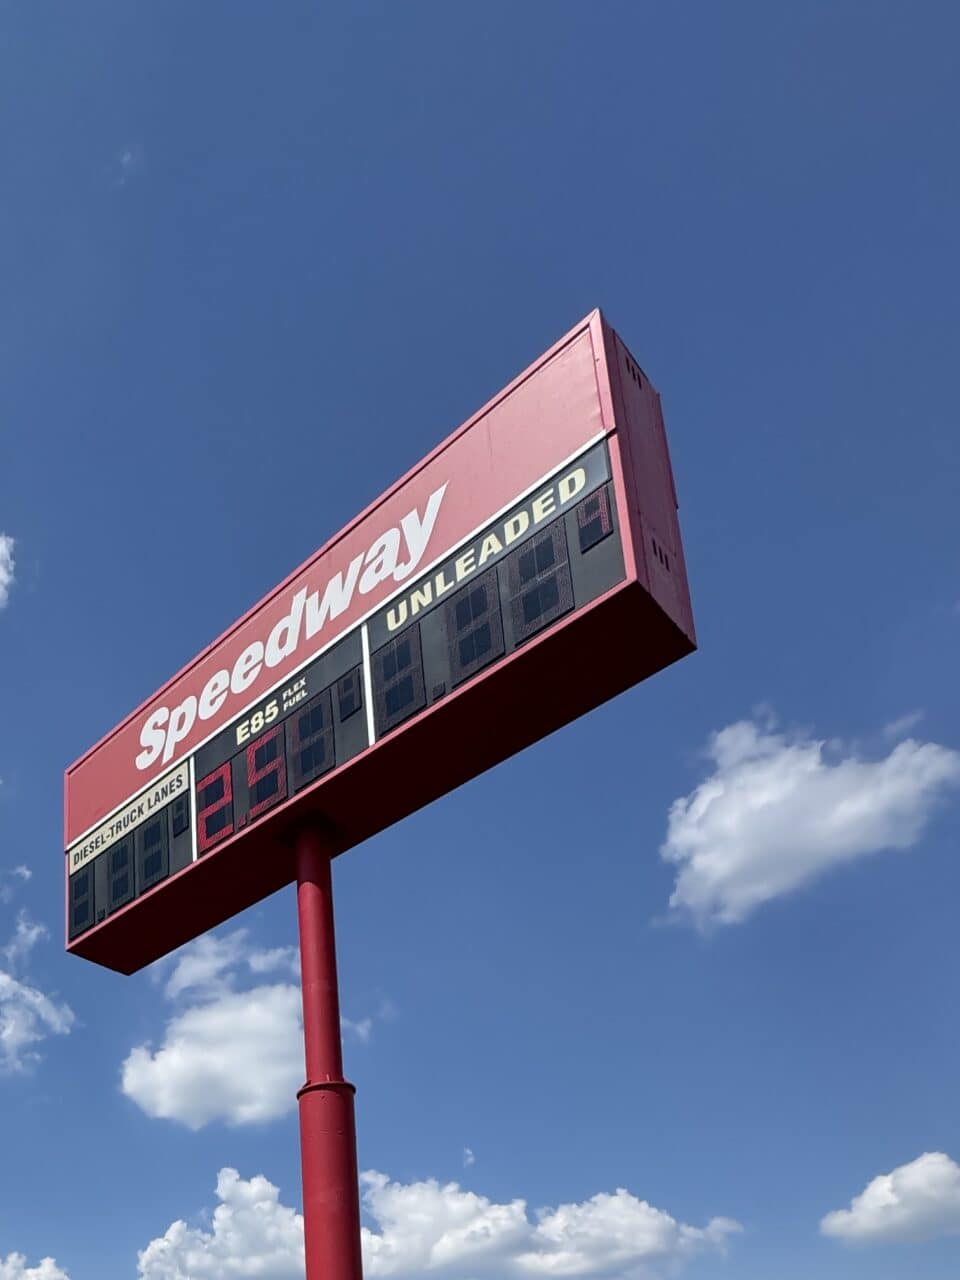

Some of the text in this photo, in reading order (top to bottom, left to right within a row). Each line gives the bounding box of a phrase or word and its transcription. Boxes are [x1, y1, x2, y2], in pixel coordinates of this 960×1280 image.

[386, 468, 586, 631] UNLEADED
[135, 480, 449, 770] Speedway
[236, 700, 279, 745] E85
[282, 677, 306, 701] FLEX
[283, 689, 308, 712] FUEL
[73, 774, 183, 866] DIESEL-TRUCK LANES
